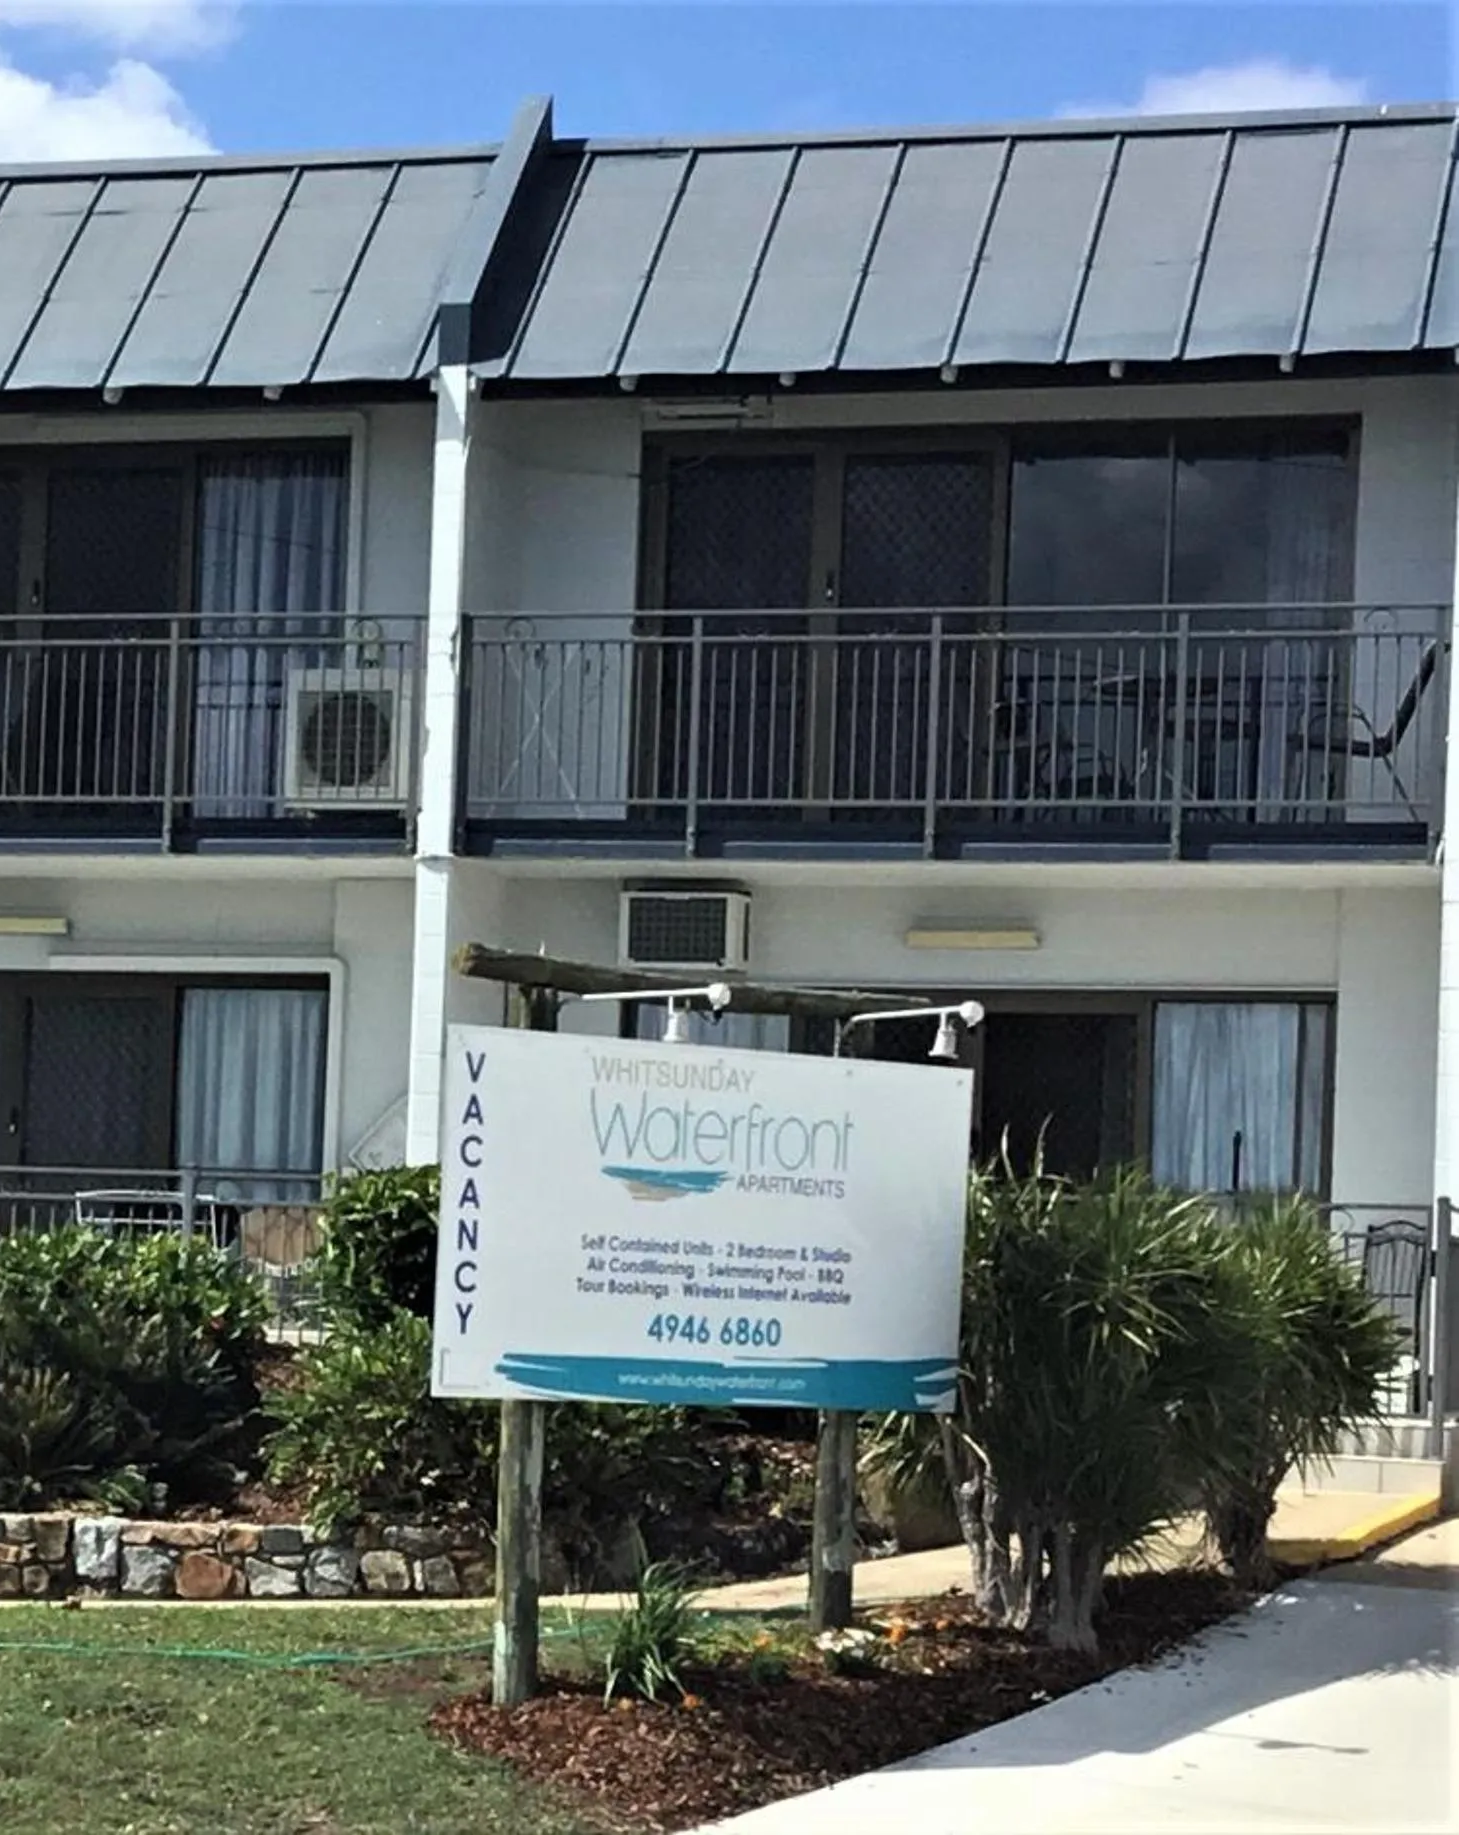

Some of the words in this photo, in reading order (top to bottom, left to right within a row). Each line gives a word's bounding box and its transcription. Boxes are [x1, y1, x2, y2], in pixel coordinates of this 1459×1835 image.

[591, 1055, 754, 1093] WHITSUNDAY
[590, 1087, 854, 1172] Waterfront
[454, 1051, 486, 1335] VACANCY
[736, 1175, 845, 1199] APARTMENTS
[581, 1234, 605, 1250] Self
[608, 1235, 680, 1254] Contained
[683, 1240, 713, 1256] Units
[726, 1241, 735, 1258] 2
[738, 1243, 797, 1261] Bedroom
[800, 1246, 809, 1261] &
[812, 1246, 851, 1263] Studio
[586, 1257, 606, 1271] Air
[608, 1257, 695, 1280] Conditioning
[708, 1262, 774, 1284] Swimming
[778, 1266, 806, 1282] Pool
[818, 1268, 844, 1284] BBQ
[577, 1277, 606, 1293] Tour
[608, 1279, 669, 1299] Bookings
[682, 1282, 735, 1300] Wireless
[738, 1284, 788, 1302] Internet
[791, 1287, 852, 1305] Available
[647, 1313, 711, 1344] 4946
[720, 1316, 782, 1347] 6860
